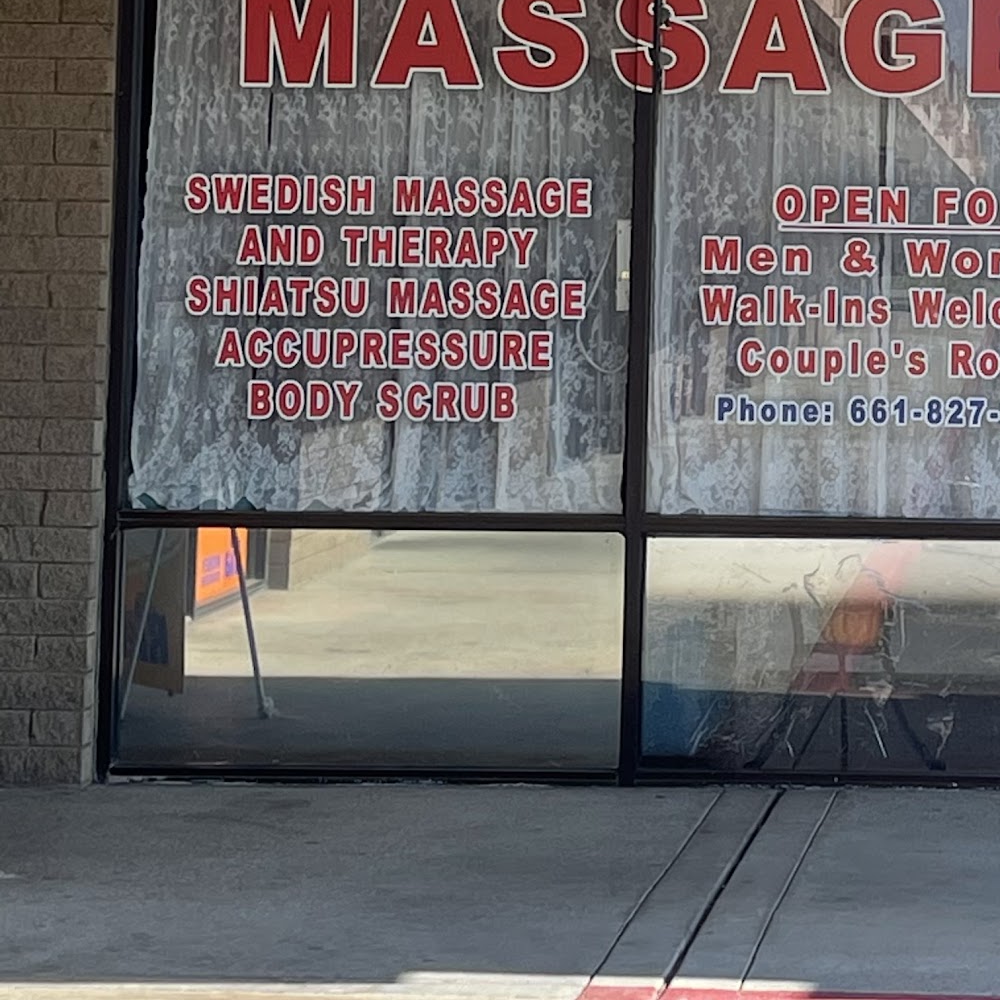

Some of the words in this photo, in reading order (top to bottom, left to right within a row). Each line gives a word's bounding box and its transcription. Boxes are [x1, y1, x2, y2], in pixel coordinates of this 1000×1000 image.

[185, 174, 376, 214] SWEDISH
[393, 177, 593, 218] MASSAGE
[773, 185, 909, 225] OPEN
[237, 224, 324, 266] AND
[342, 226, 537, 268] THERAPY
[701, 236, 813, 275] Men
[841, 238, 877, 276] &
[185, 276, 369, 317] SHIATSU
[387, 278, 587, 320] MASSAGE
[700, 286, 891, 327] Walk-Ins
[216, 328, 554, 370] ACCUPRESSURE
[737, 339, 928, 384] Couple's
[247, 380, 360, 420] BODY
[377, 382, 517, 422] SCRUB
[715, 395, 833, 426] Phone:
